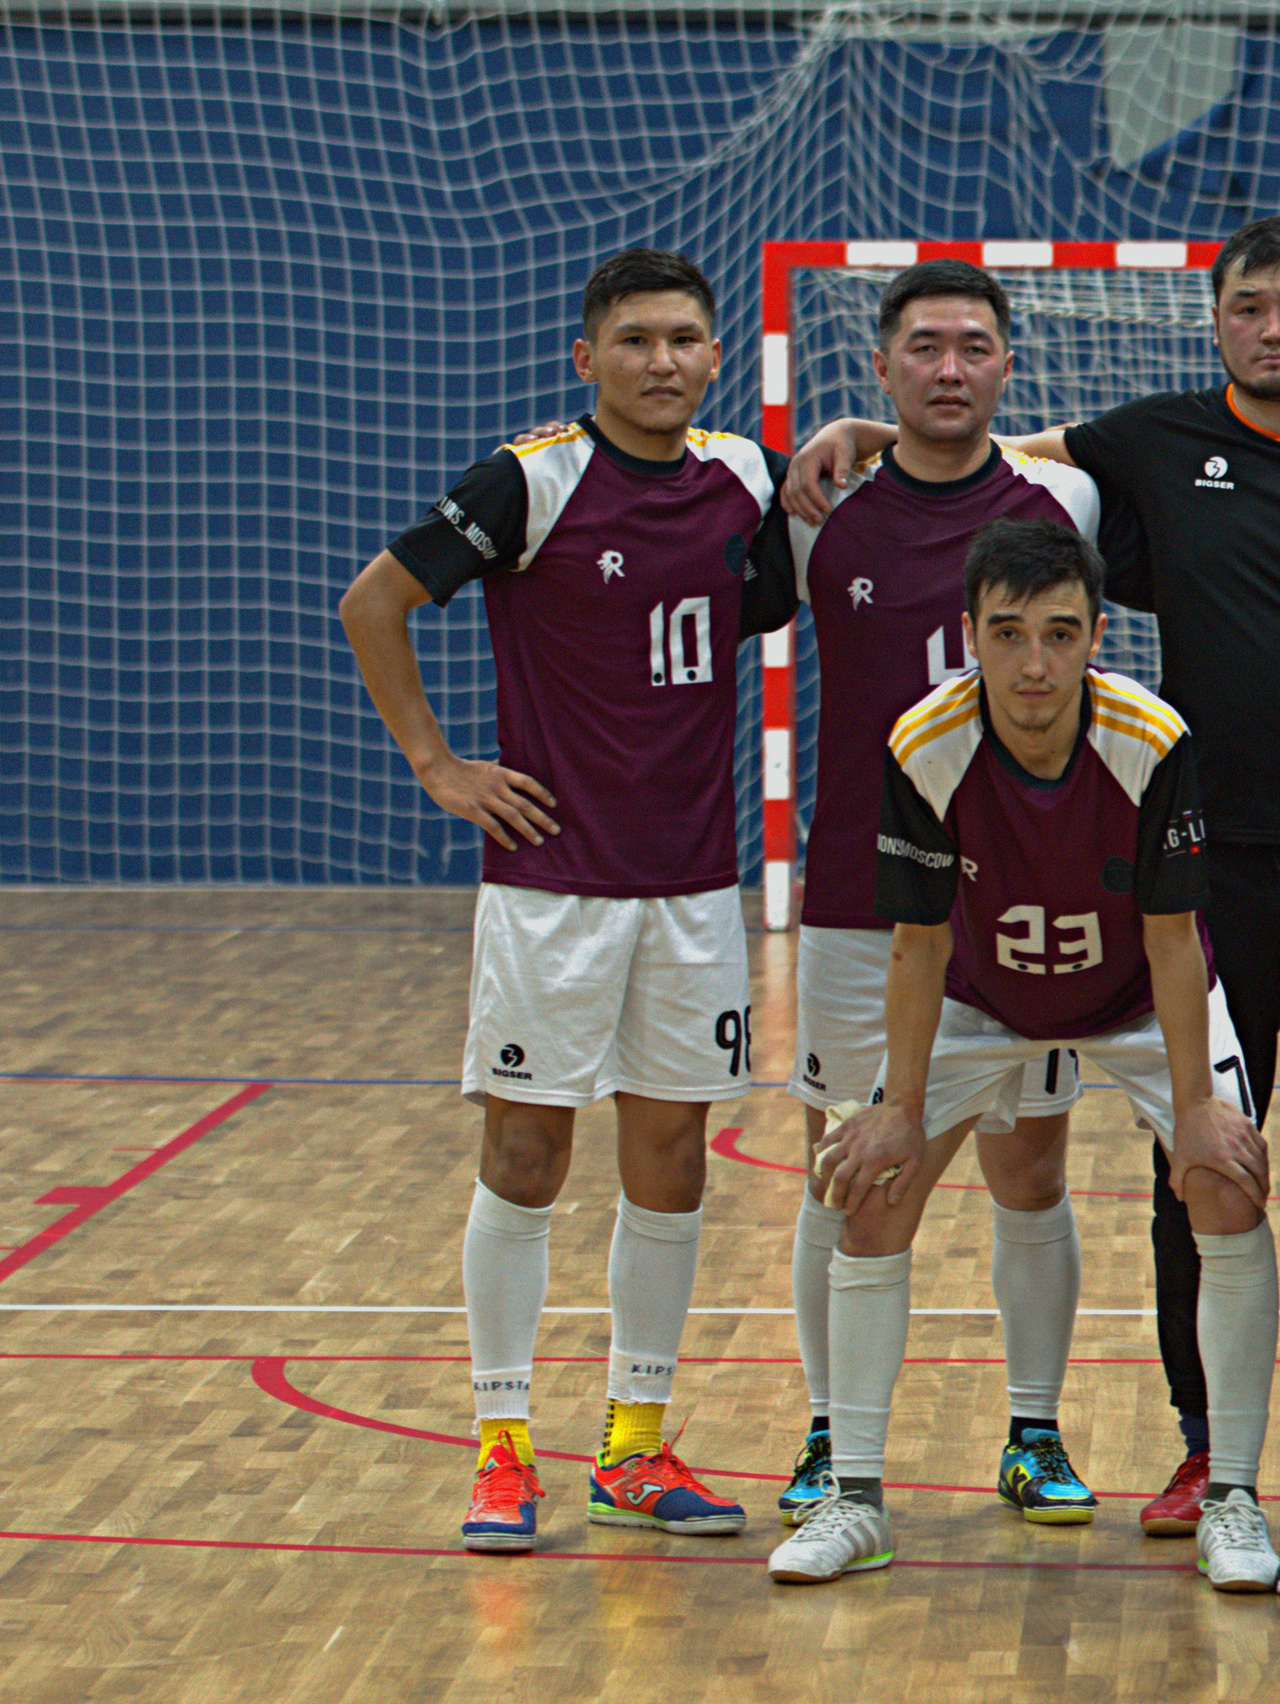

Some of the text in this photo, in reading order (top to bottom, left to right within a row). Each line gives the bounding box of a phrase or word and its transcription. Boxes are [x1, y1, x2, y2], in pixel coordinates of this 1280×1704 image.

[1194, 479, 1235, 490] BIGSER
[649, 596, 714, 687] 10
[996, 904, 1104, 975] 23
[491, 1067, 533, 1081] BIGSER
